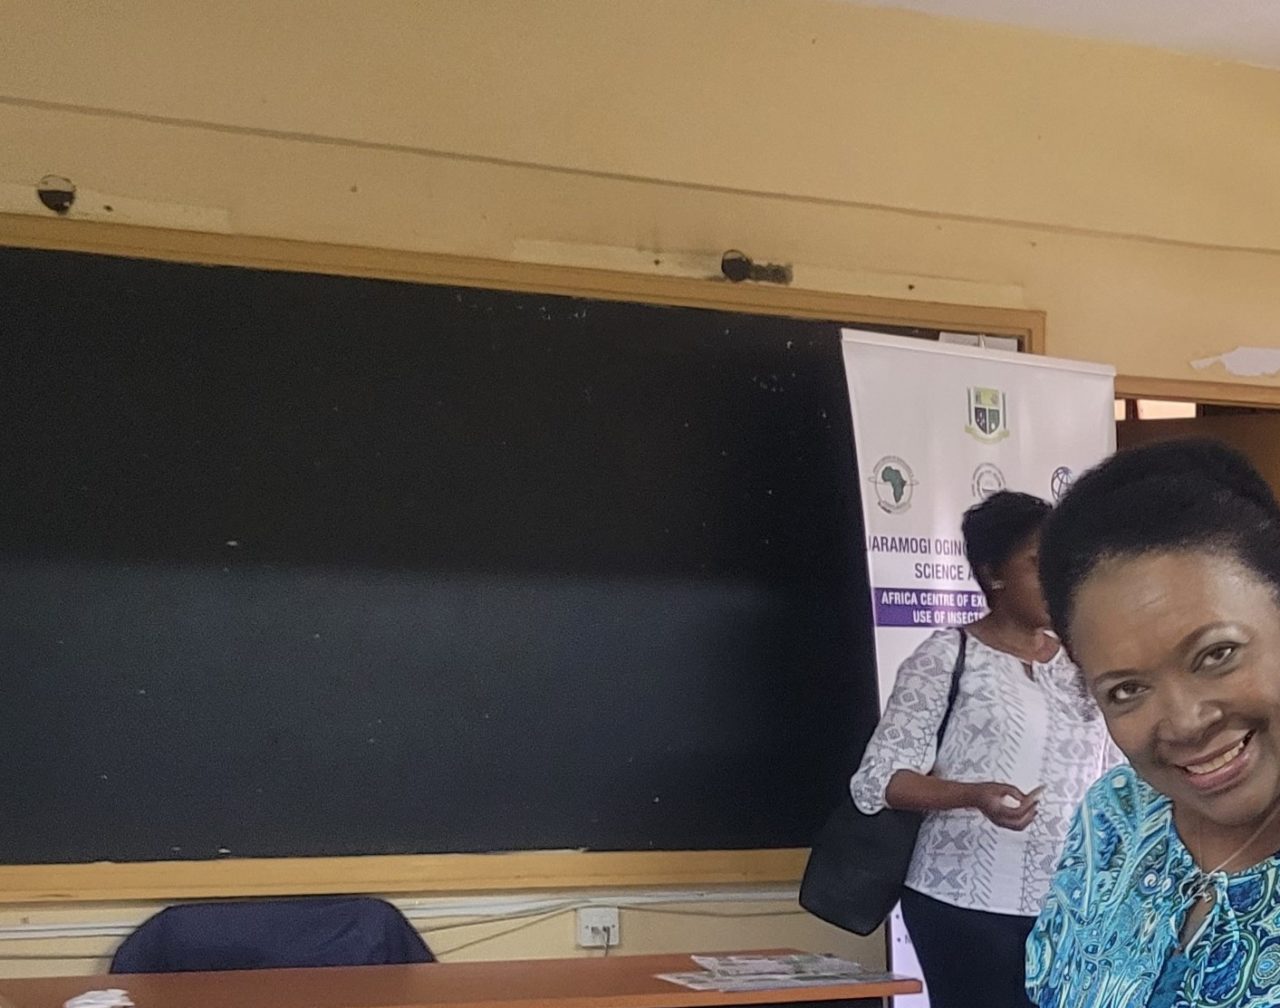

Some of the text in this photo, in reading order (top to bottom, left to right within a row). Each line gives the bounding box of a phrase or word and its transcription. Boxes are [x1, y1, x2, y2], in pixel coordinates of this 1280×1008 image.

[914, 563, 964, 580] SCIENCE
[881, 591, 918, 606] AFRICA
[921, 592, 955, 607] CENTRE
[957, 594, 969, 607] OF
[912, 610, 932, 624] USE
[934, 611, 945, 624] OF
